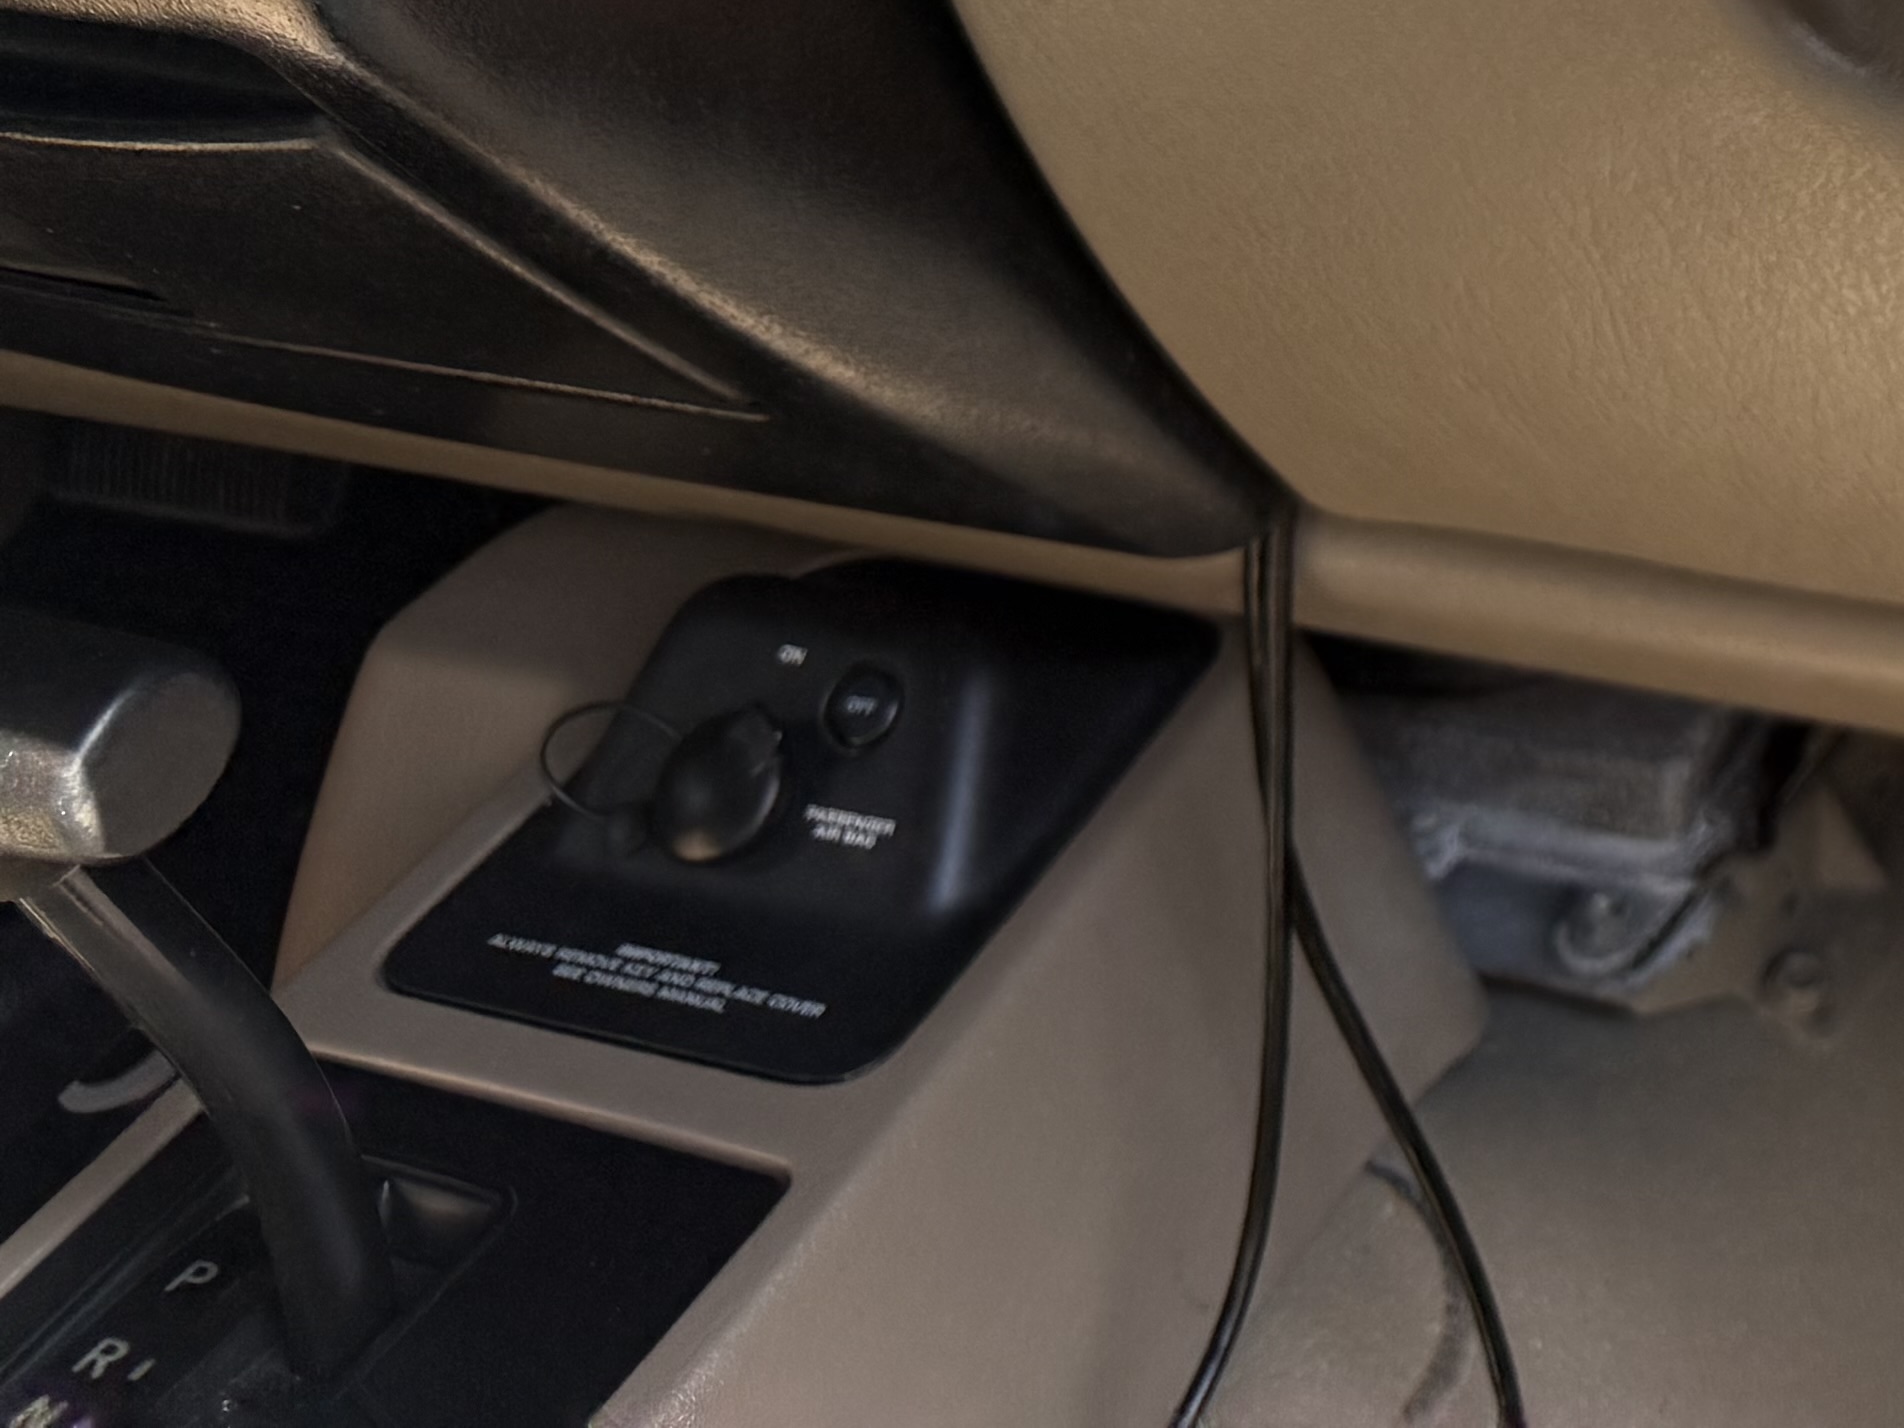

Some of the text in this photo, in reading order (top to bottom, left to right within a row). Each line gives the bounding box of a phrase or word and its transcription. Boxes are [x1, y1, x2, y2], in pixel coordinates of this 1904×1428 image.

[778, 644, 808, 665] ON
[847, 695, 877, 716] OFF
[804, 803, 896, 837] PASSENGER
[164, 1259, 218, 1292] P
[71, 1337, 131, 1380] R
